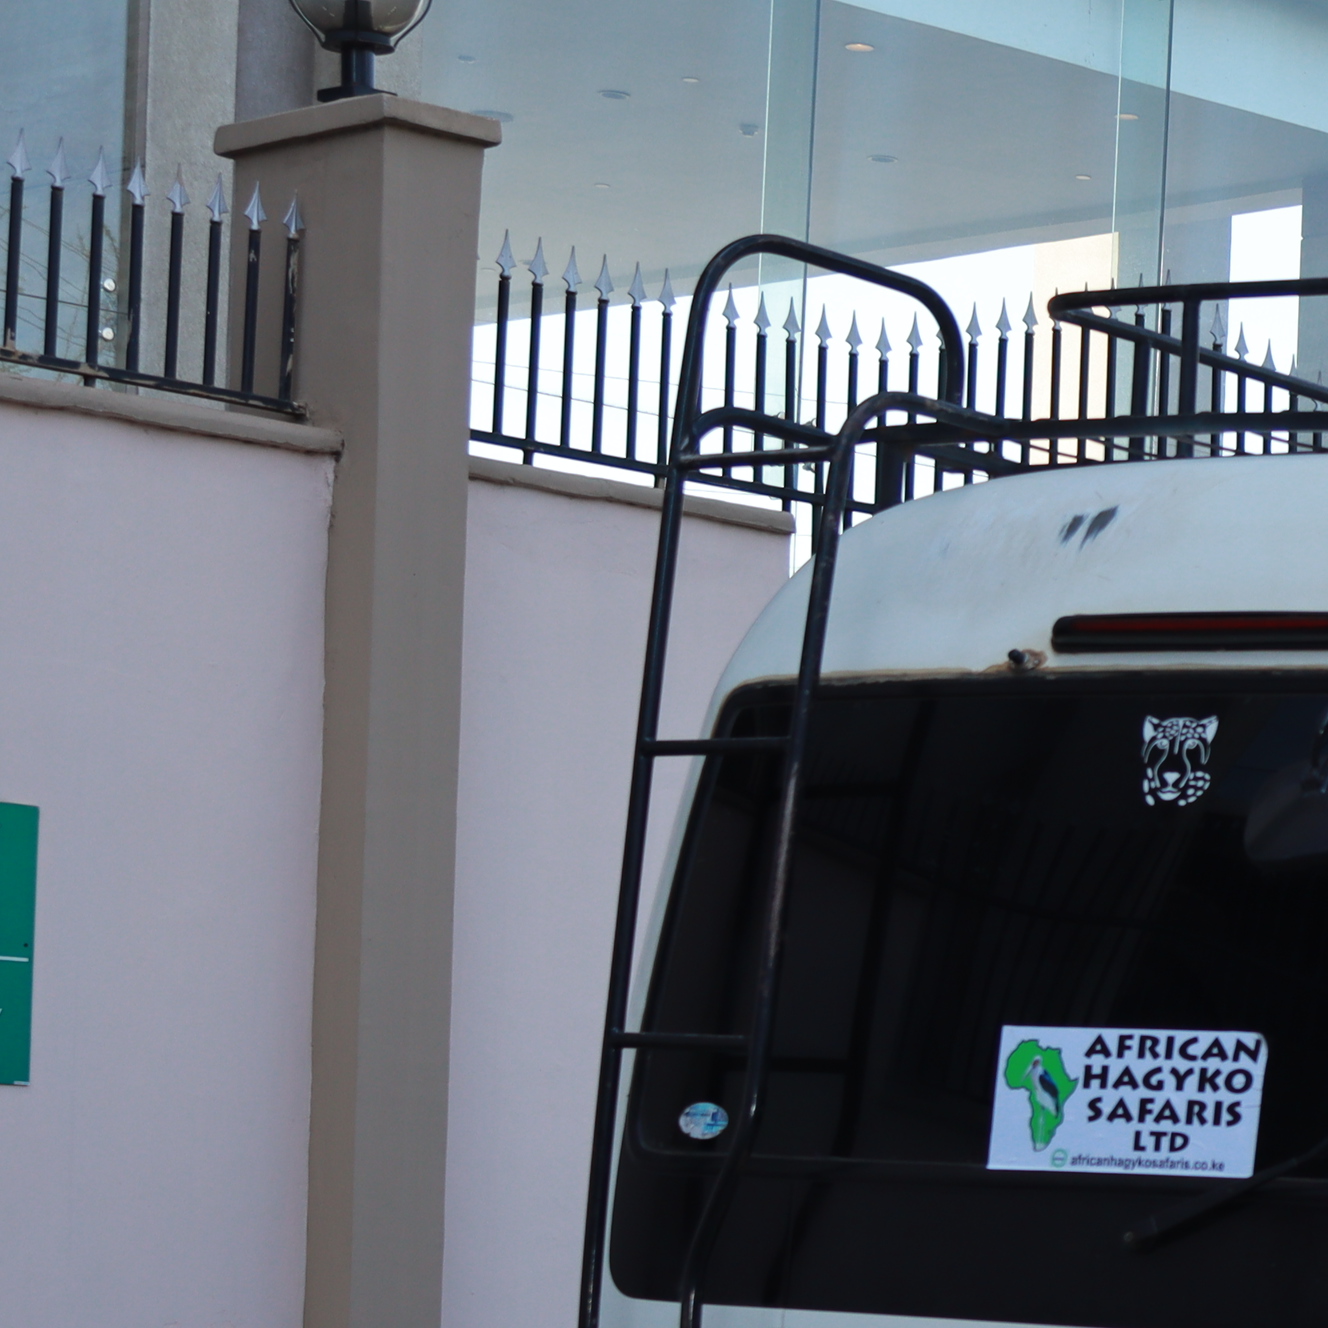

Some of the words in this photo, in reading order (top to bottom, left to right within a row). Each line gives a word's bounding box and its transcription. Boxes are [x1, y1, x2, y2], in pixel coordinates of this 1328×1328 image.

[1084, 1034, 1262, 1063] AFRICAN
[1082, 1065, 1253, 1094] HAGYKO
[1087, 1097, 1242, 1126] SAFARIS
[1132, 1130, 1190, 1153] LTD
[1070, 1154, 1226, 1171] africanhagykosafaris.co.ke
